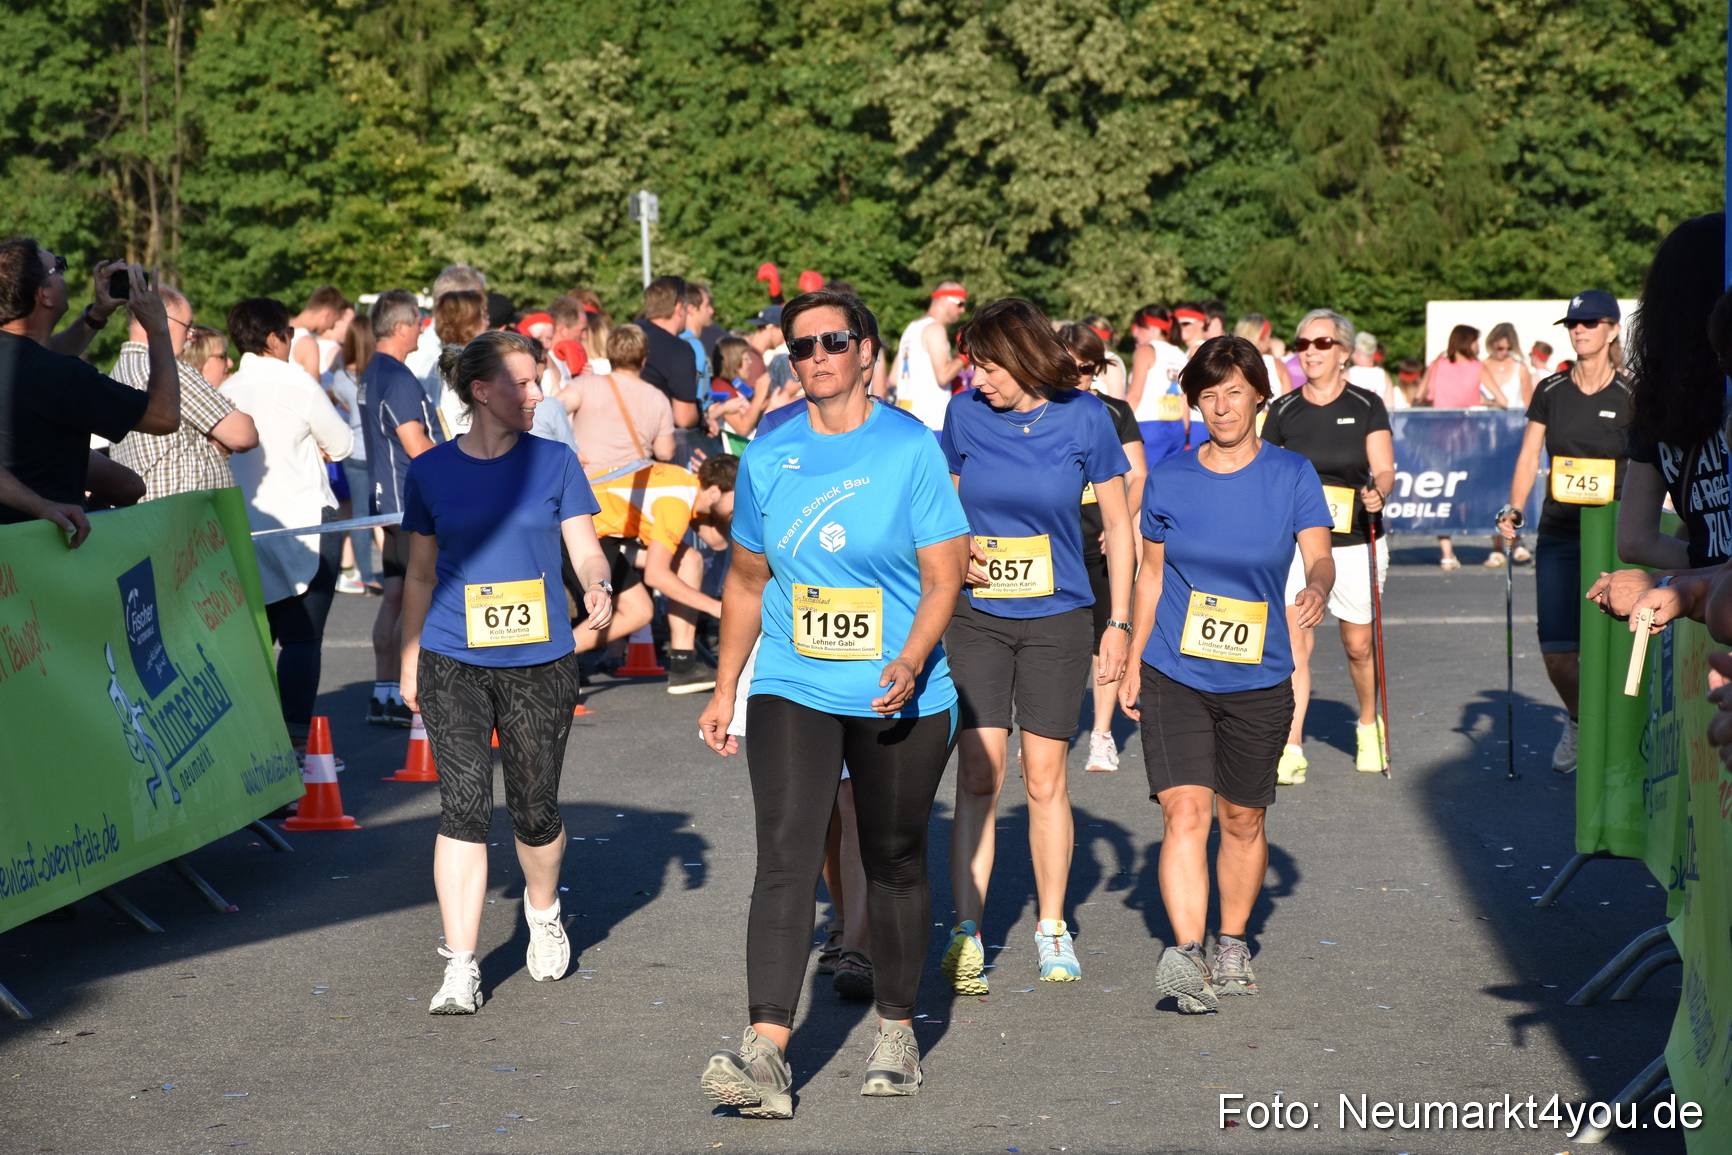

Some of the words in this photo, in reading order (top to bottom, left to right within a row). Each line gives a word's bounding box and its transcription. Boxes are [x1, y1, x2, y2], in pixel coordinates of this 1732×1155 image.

[1565, 474, 1599, 492] 745
[777, 518, 803, 550] Team
[802, 486, 842, 517] Schick
[842, 476, 870, 490] Bau
[988, 559, 1034, 581] 657
[484, 603, 531, 628] 673
[802, 611, 869, 639] 1195
[489, 628, 505, 636] Kolb
[812, 638, 836, 646] Lehner
[838, 639, 855, 647] Gabi
[1201, 617, 1249, 645] 670
[1198, 640, 1223, 650] Lindner
[1224, 644, 1248, 653] Martina
[138, 642, 233, 762] firmenlauf
[179, 742, 215, 791] neumarkt
